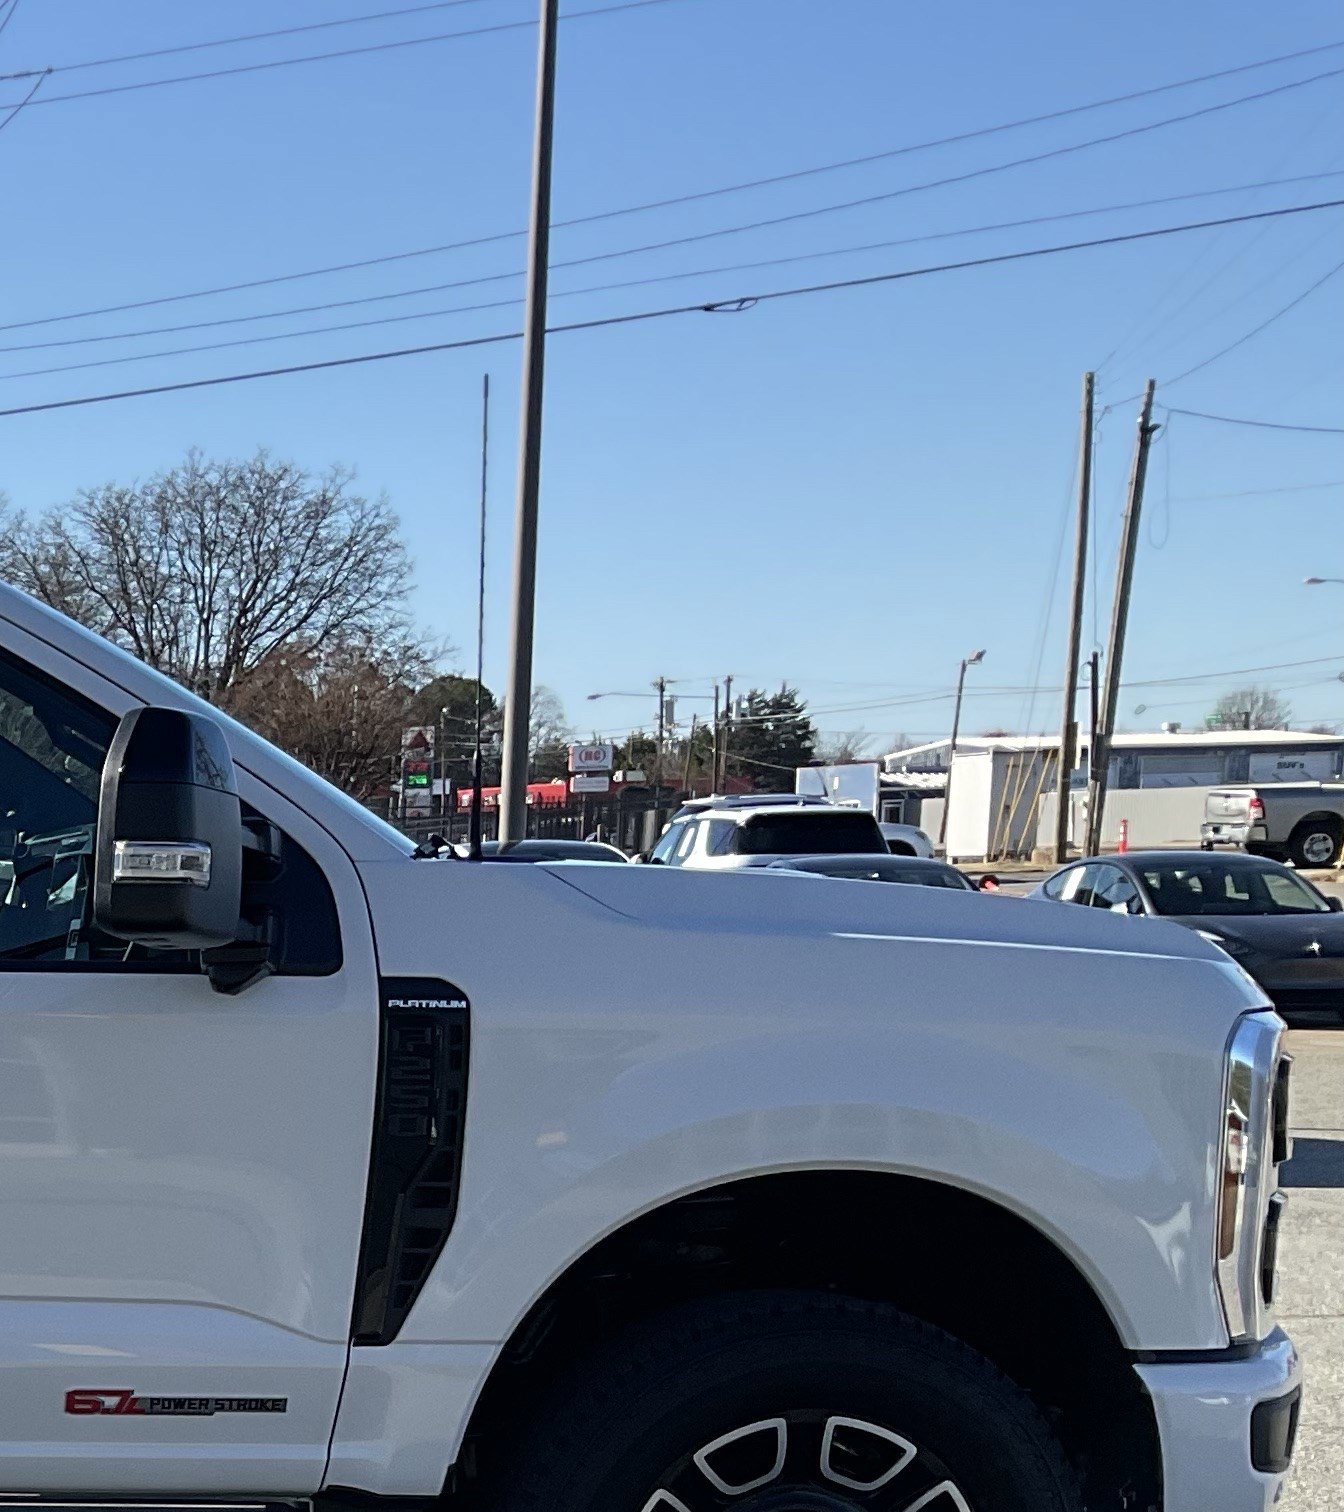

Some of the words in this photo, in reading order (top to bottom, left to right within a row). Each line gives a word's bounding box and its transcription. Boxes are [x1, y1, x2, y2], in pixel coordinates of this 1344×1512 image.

[388, 999, 466, 1009] PLATINUM
[150, 1398, 210, 1410] POWER
[213, 1398, 286, 1411] STROKE
